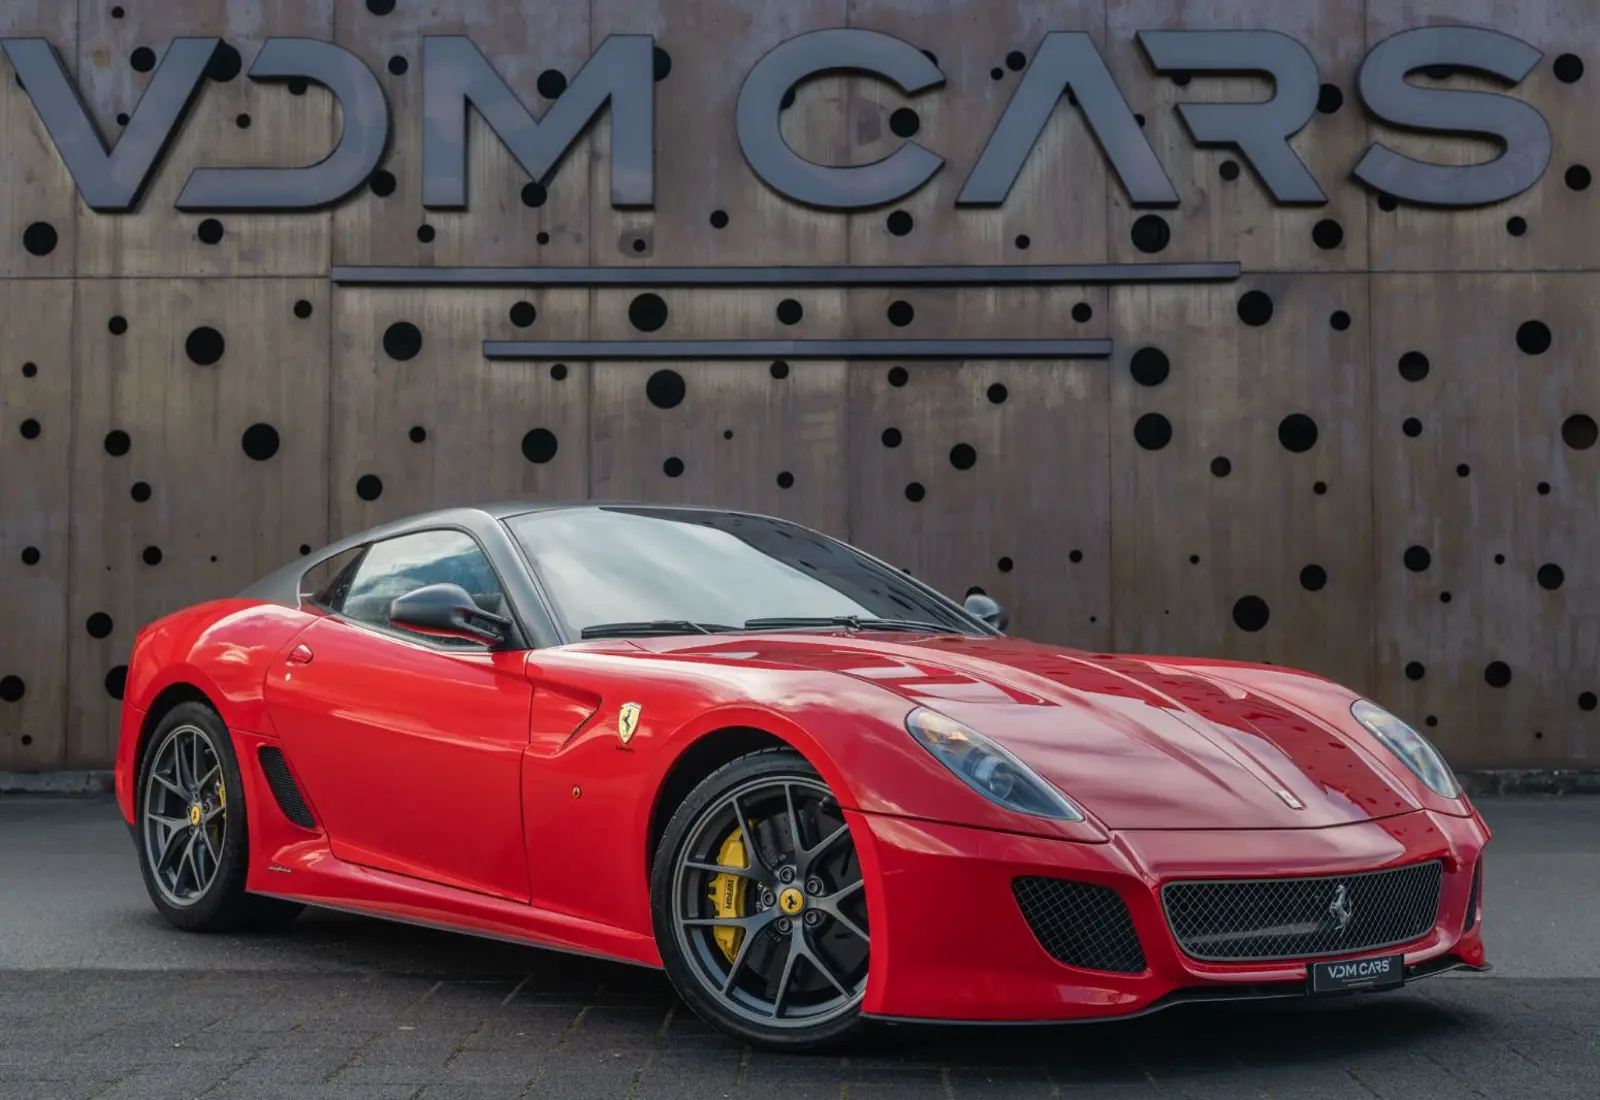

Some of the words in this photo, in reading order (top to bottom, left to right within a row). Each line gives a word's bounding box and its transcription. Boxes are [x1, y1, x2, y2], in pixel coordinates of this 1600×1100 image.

[1, 35, 655, 212] VDM
[736, 27, 1553, 208] CARS
[1328, 963, 1357, 979] VDM
[1359, 959, 1390, 975] CARS
